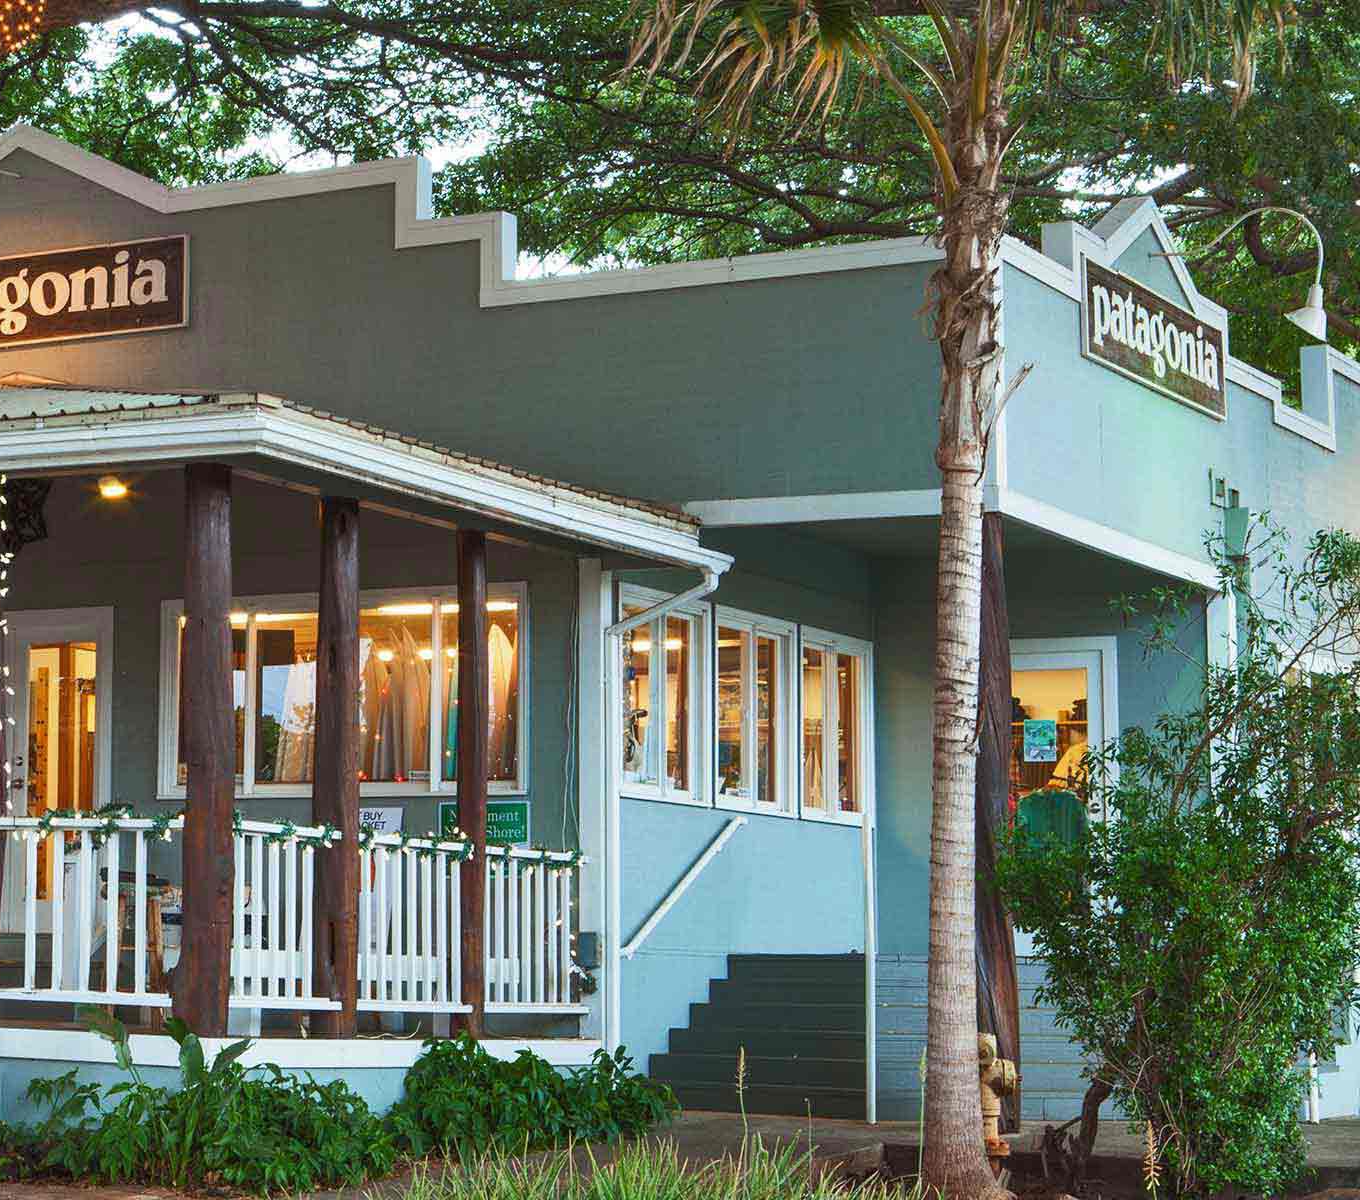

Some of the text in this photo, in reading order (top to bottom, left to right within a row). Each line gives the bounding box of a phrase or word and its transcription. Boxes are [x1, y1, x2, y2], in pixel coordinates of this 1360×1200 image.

[1092, 284, 1220, 391] patagonia
[363, 811, 384, 820] BUY
[487, 811, 519, 822] ment
